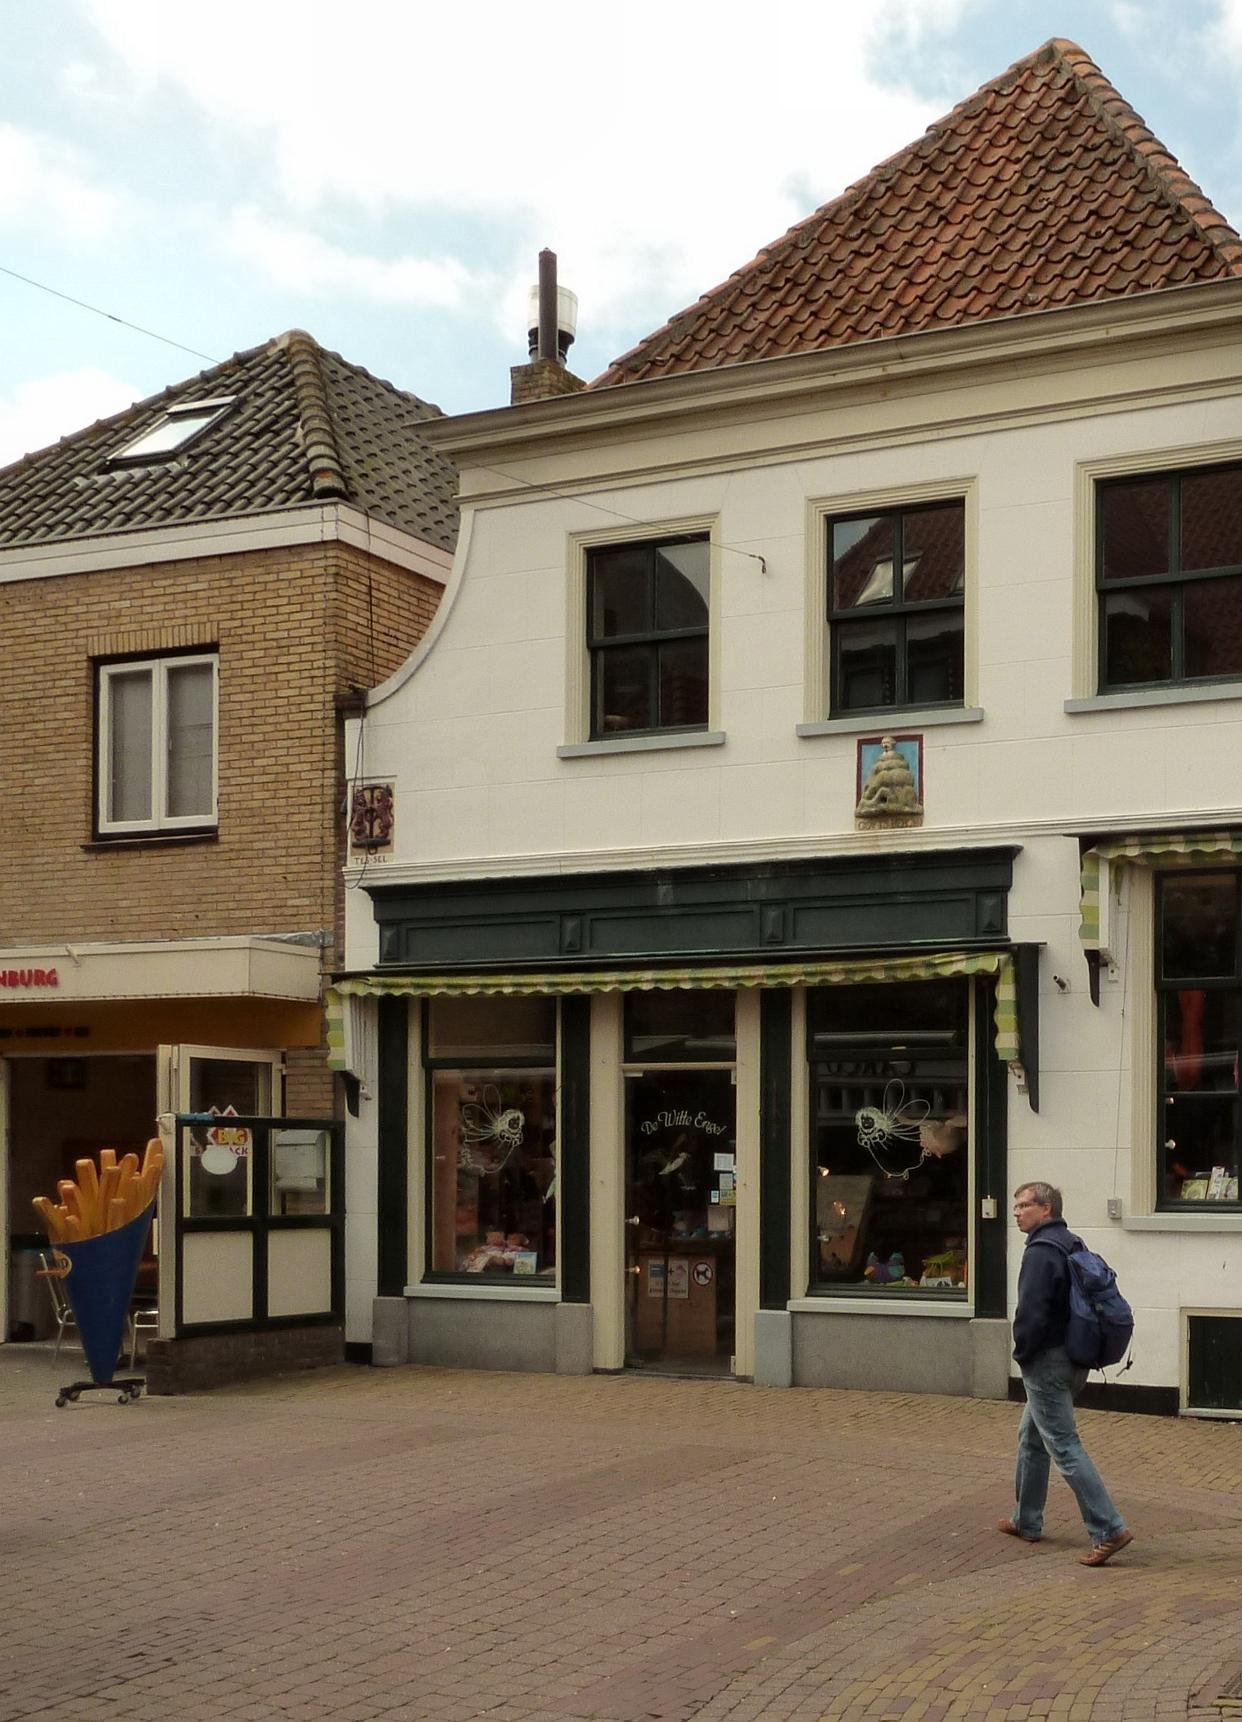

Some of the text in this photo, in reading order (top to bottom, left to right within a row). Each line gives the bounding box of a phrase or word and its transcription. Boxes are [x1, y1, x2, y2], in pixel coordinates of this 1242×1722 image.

[640, 1109, 728, 1135] De Witte Engel
